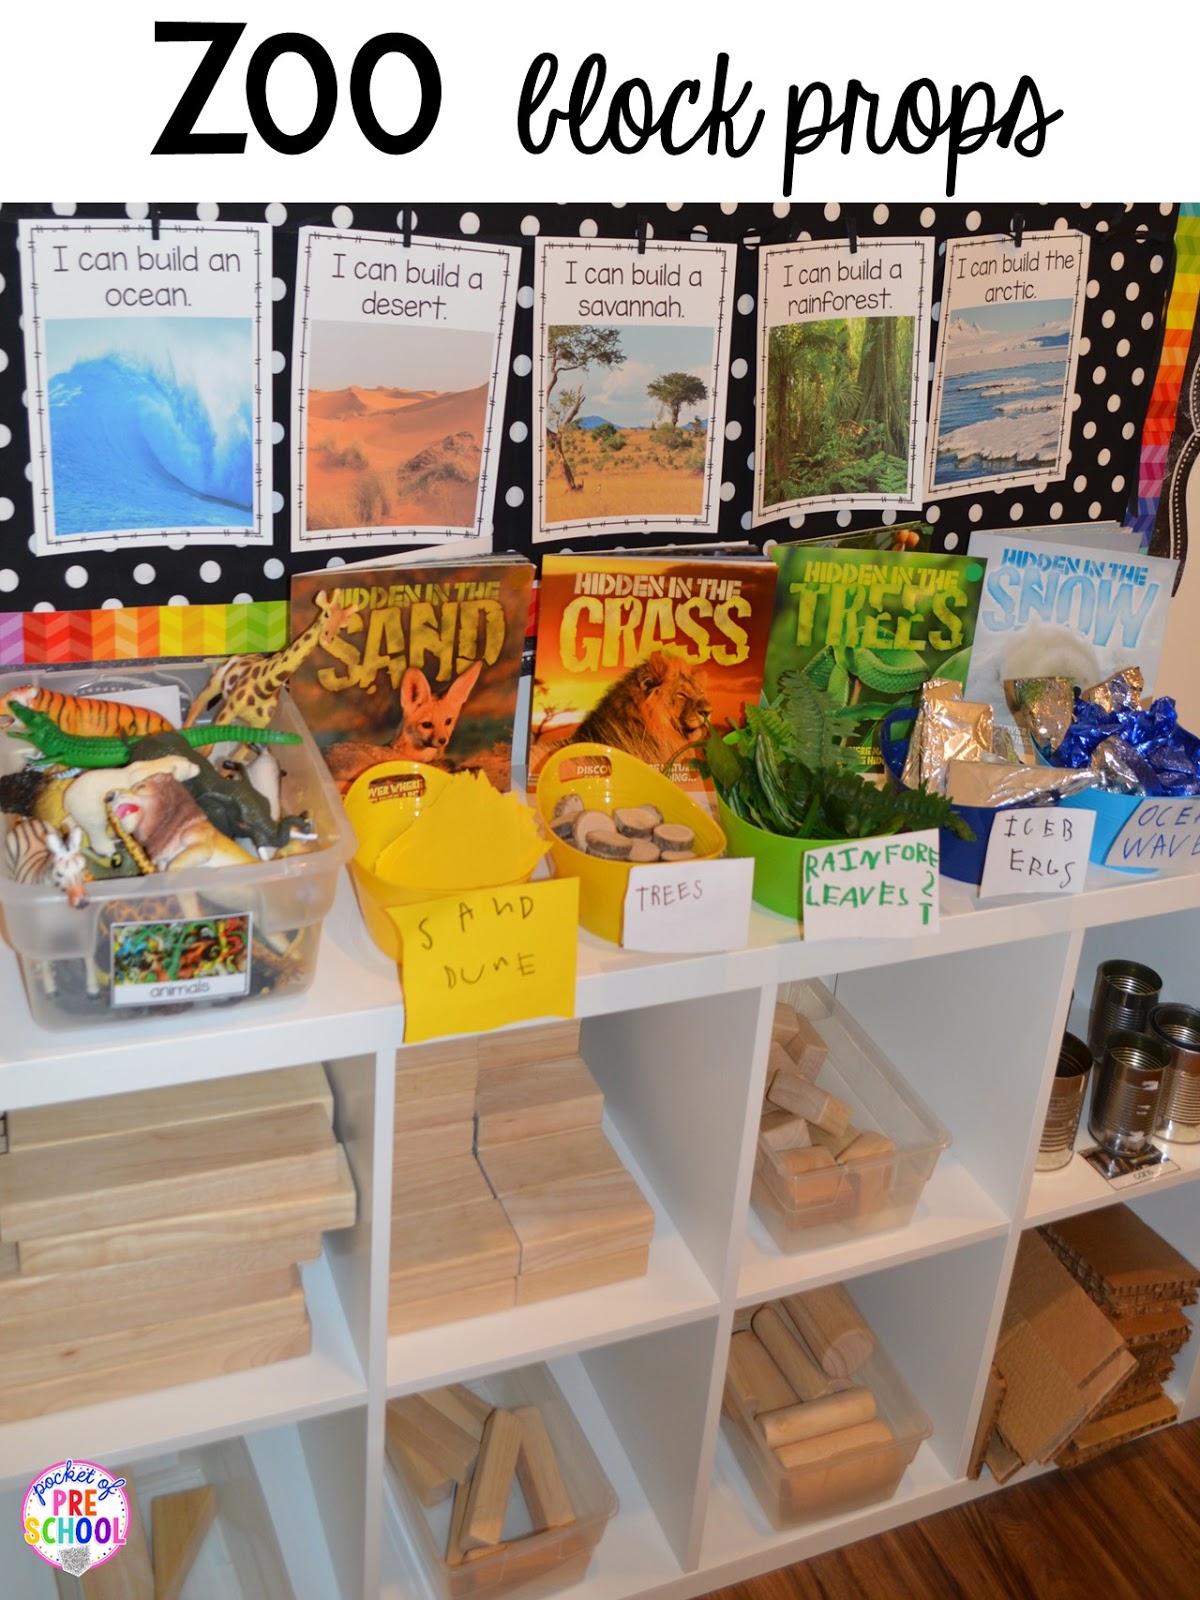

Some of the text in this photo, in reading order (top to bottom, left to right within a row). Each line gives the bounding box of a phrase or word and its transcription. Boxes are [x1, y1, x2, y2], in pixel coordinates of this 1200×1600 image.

[53, 245, 241, 273] I can build an
[331, 252, 483, 290] I can build a
[783, 258, 902, 287] I can build a
[956, 250, 1075, 279] I can build the
[565, 261, 702, 287] I can build a
[105, 287, 192, 306] ocean.
[361, 290, 447, 320] desert.
[788, 287, 893, 316] rainforest.
[984, 280, 1037, 303] arctic.
[578, 295, 685, 318] savannah.
[804, 560, 960, 590] HIDDEN IN THE
[1001, 548, 1148, 586] HIDDEN IN THE
[425, 583, 450, 605] IN
[454, 581, 501, 601] THE
[574, 572, 742, 601] HIDDEN IN THE
[789, 582, 968, 651] TREES
[982, 564, 1160, 648] SNOW
[317, 599, 506, 695] SAND
[559, 595, 752, 673] GRASS
[1004, 815, 1073, 842] ICEB
[1010, 848, 1076, 889] ERGS
[635, 880, 703, 911] TREES
[806, 881, 909, 908] LEAVES
[150, 981, 210, 998] animals
